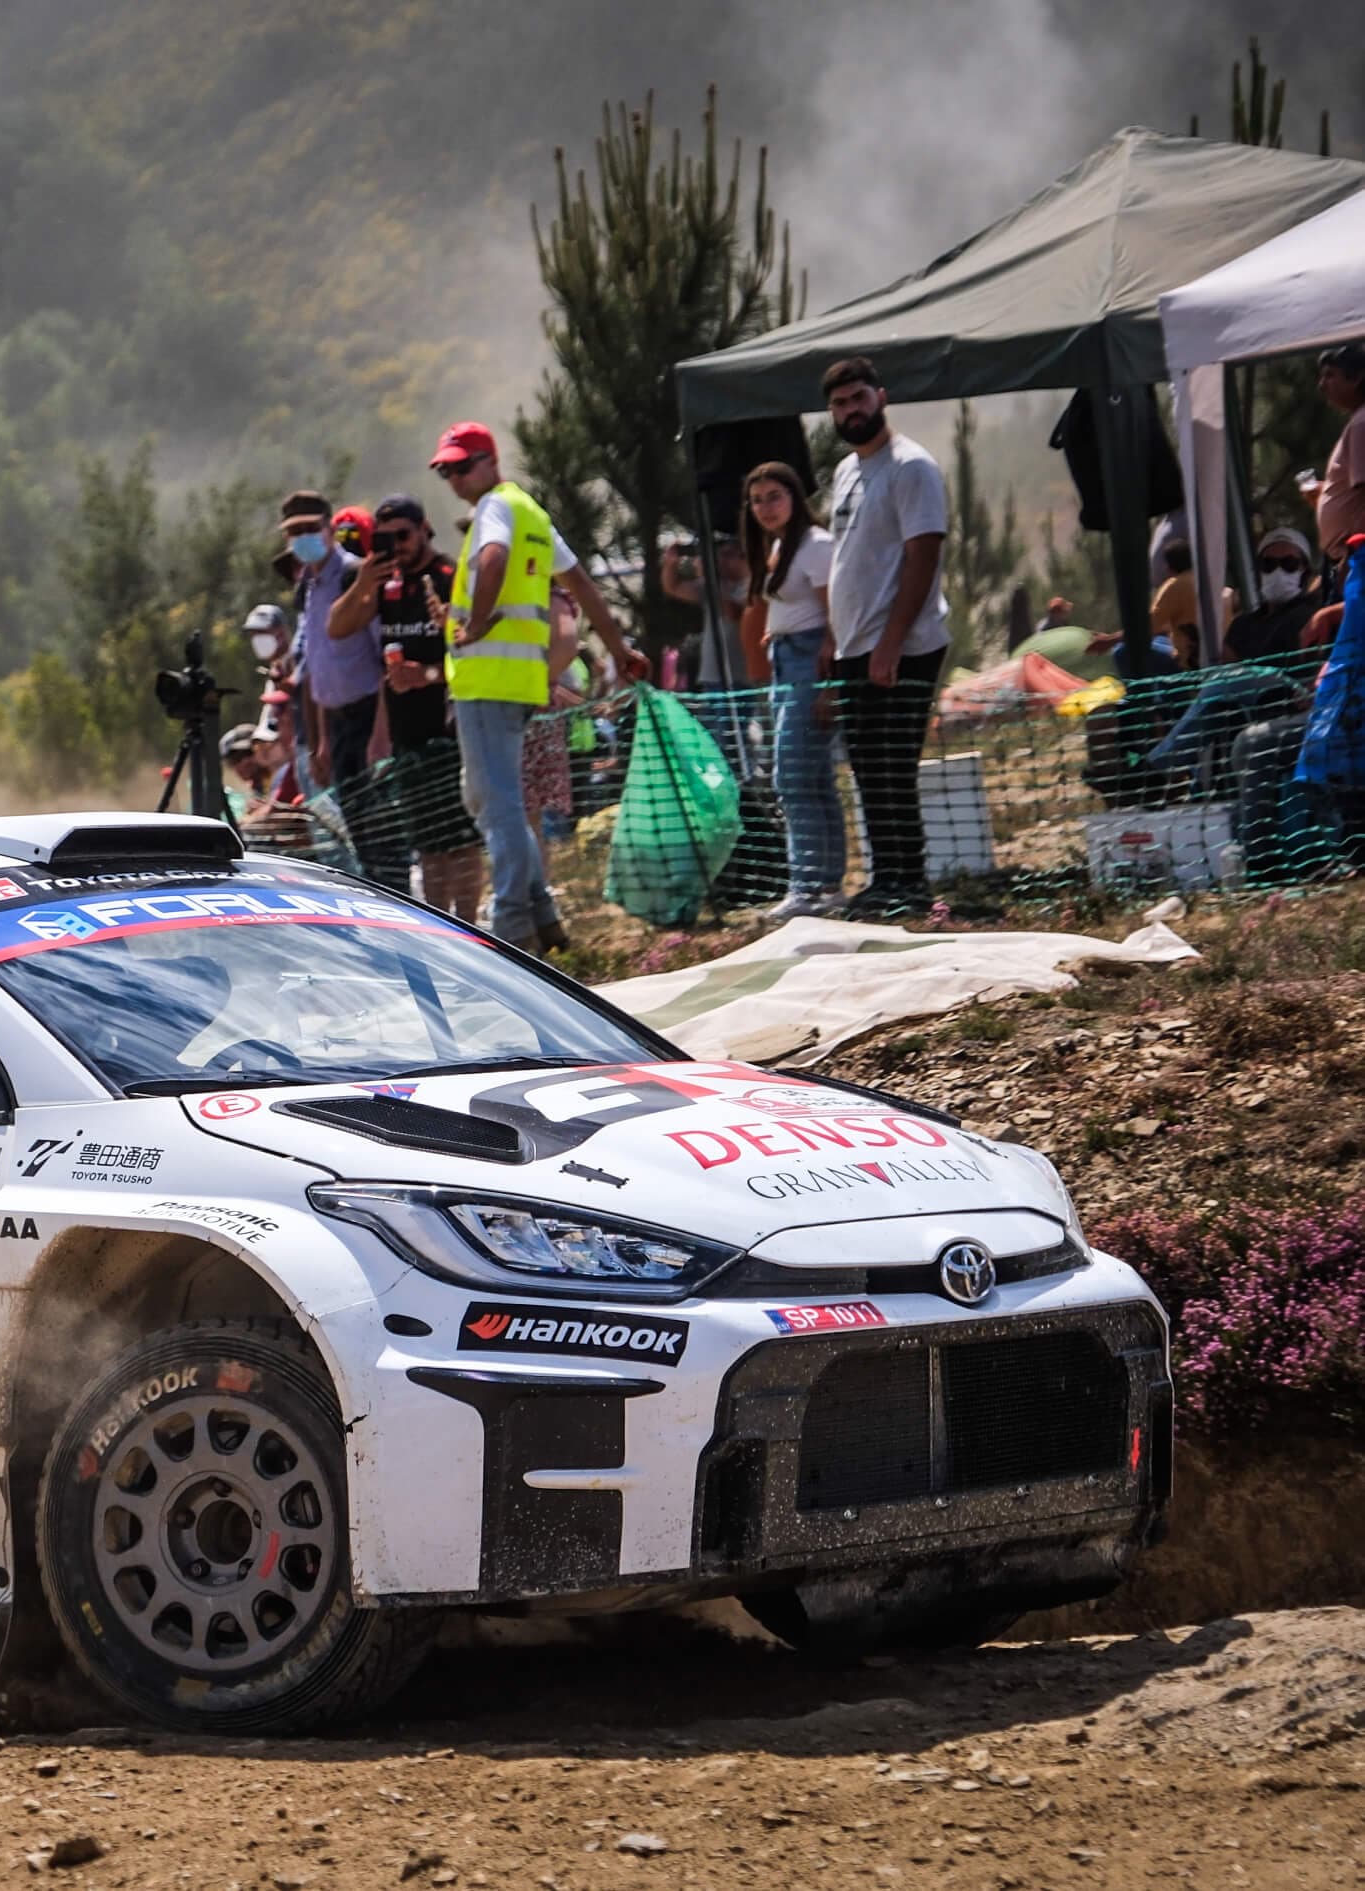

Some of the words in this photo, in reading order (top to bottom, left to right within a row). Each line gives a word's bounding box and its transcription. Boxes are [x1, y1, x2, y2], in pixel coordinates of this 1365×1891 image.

[27, 870, 163, 891] TOYOTA
[75, 1142, 165, 1171] 豊田通商
[665, 1117, 947, 1171] DENSO
[71, 1170, 109, 1183] TOYOTA
[111, 1172, 153, 1185] TSUSHO
[784, 1307, 820, 1329] SP
[824, 1303, 879, 1327] 1011
